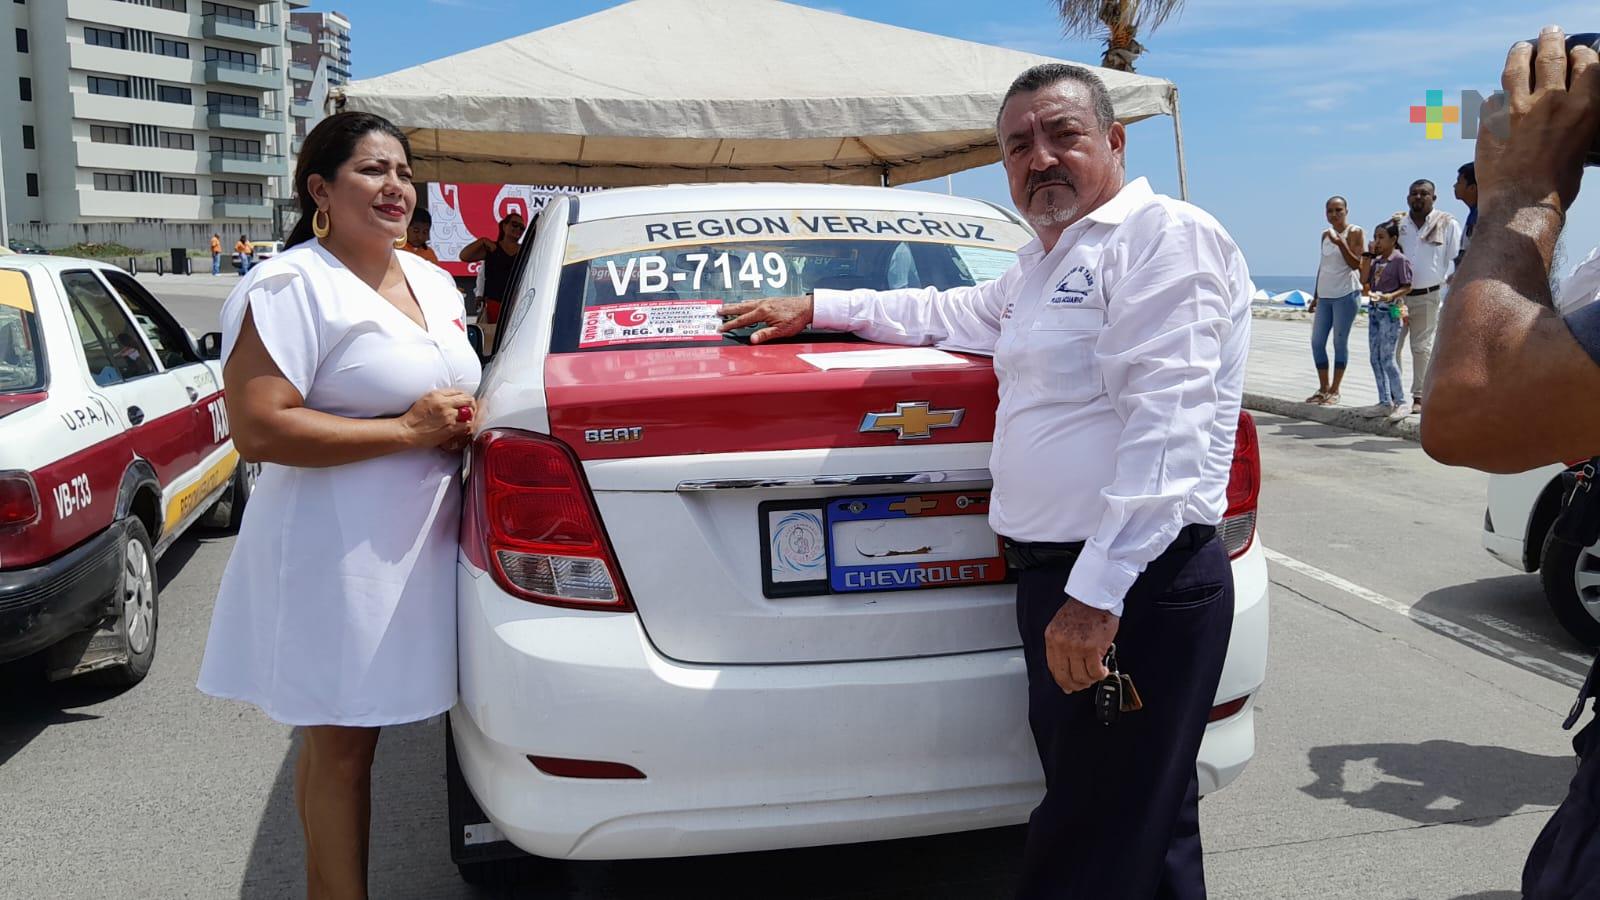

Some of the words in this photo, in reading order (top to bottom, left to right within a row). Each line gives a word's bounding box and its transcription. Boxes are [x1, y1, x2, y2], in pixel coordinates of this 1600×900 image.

[645, 216, 790, 242] REGION
[797, 215, 995, 242] VERACRUZ
[606, 251, 788, 296] VB-7149
[622, 328, 653, 336] REG.
[657, 326, 674, 334] VB
[584, 426, 643, 442] BEAT
[53, 473, 92, 520] VB-733
[844, 564, 989, 588] CHEVROLET
